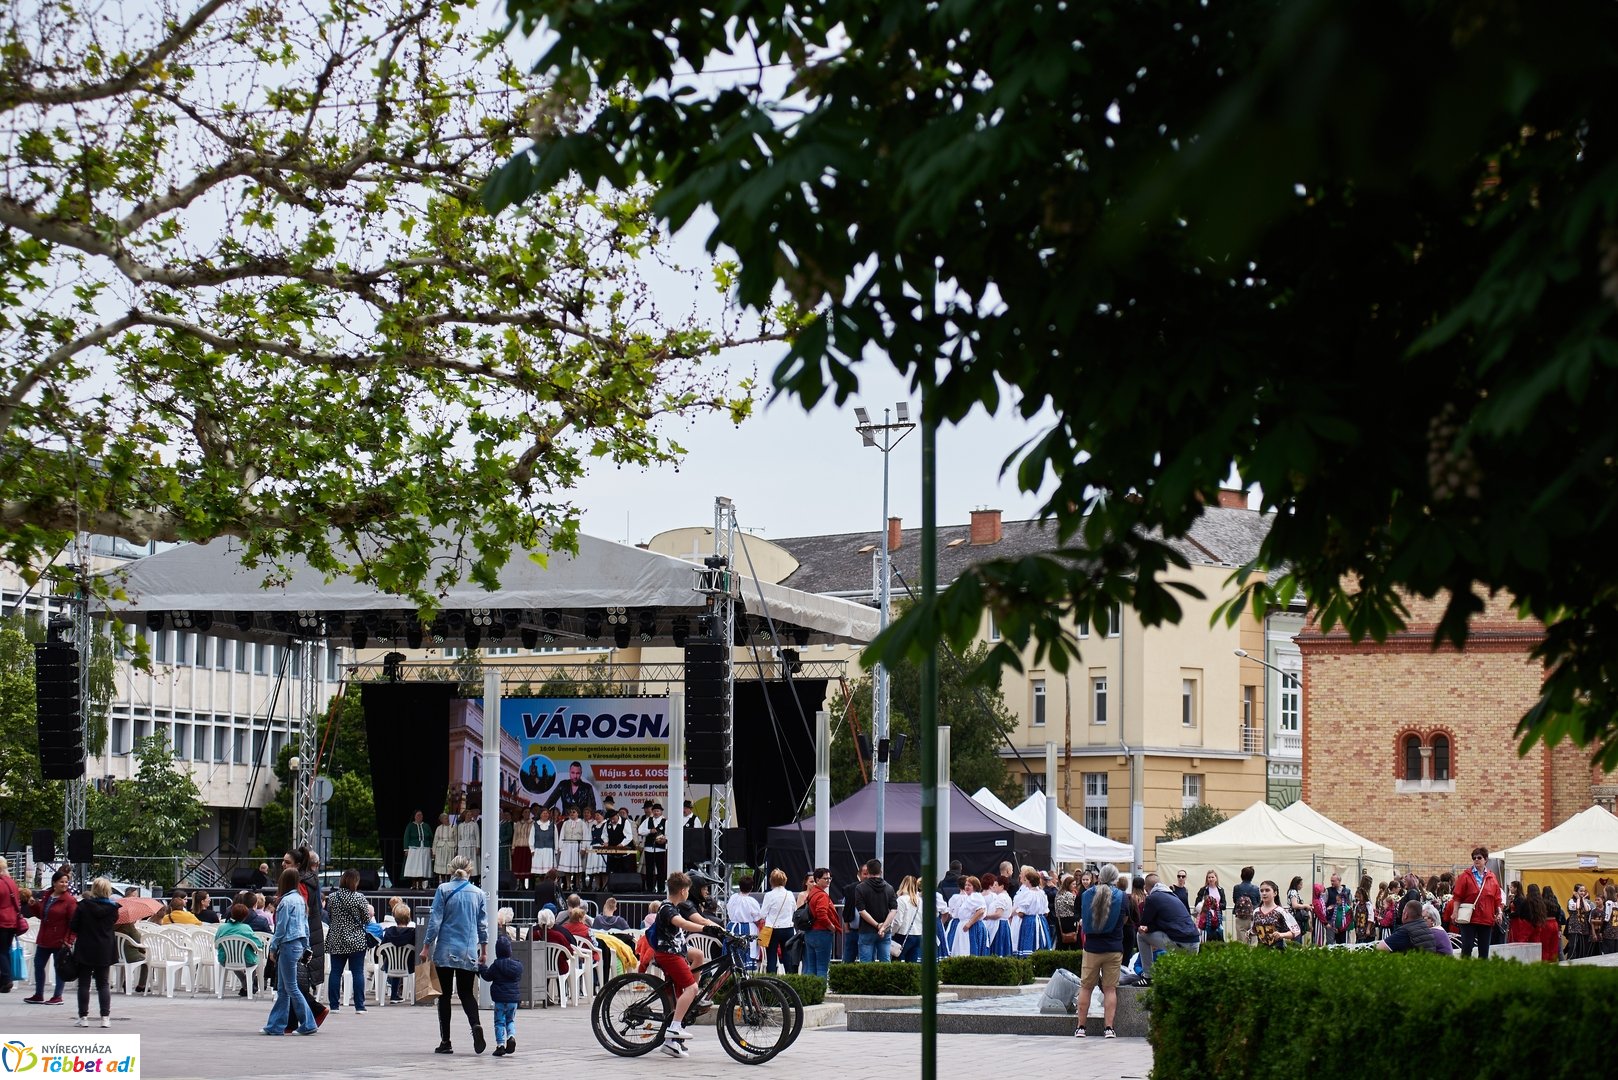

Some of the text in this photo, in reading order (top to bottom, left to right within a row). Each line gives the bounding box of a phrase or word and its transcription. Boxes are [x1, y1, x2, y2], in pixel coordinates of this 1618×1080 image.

[600, 769, 669, 779] Május 16. KOSS
